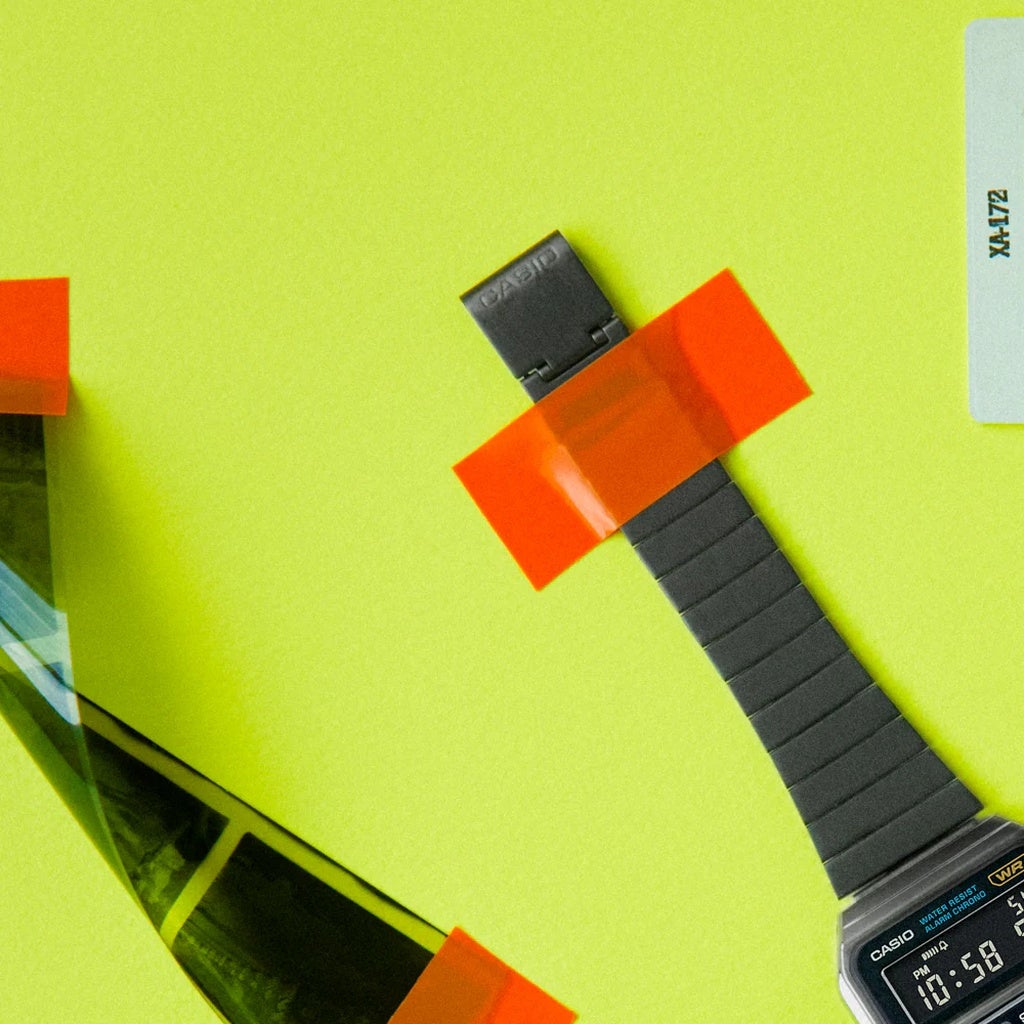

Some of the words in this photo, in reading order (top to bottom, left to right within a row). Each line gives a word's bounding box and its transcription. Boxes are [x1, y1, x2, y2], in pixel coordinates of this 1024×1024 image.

[987, 188, 1010, 259] XA-172
[479, 246, 559, 309] CASIO
[995, 860, 1024, 882] WR
[919, 904, 949, 926] WATER
[948, 884, 979, 907] RESIST
[925, 912, 952, 934] ALARM
[952, 890, 987, 915] CHRONO
[870, 929, 915, 962] CASIO
[912, 964, 931, 981] PM
[917, 940, 1004, 1011] 10:58
